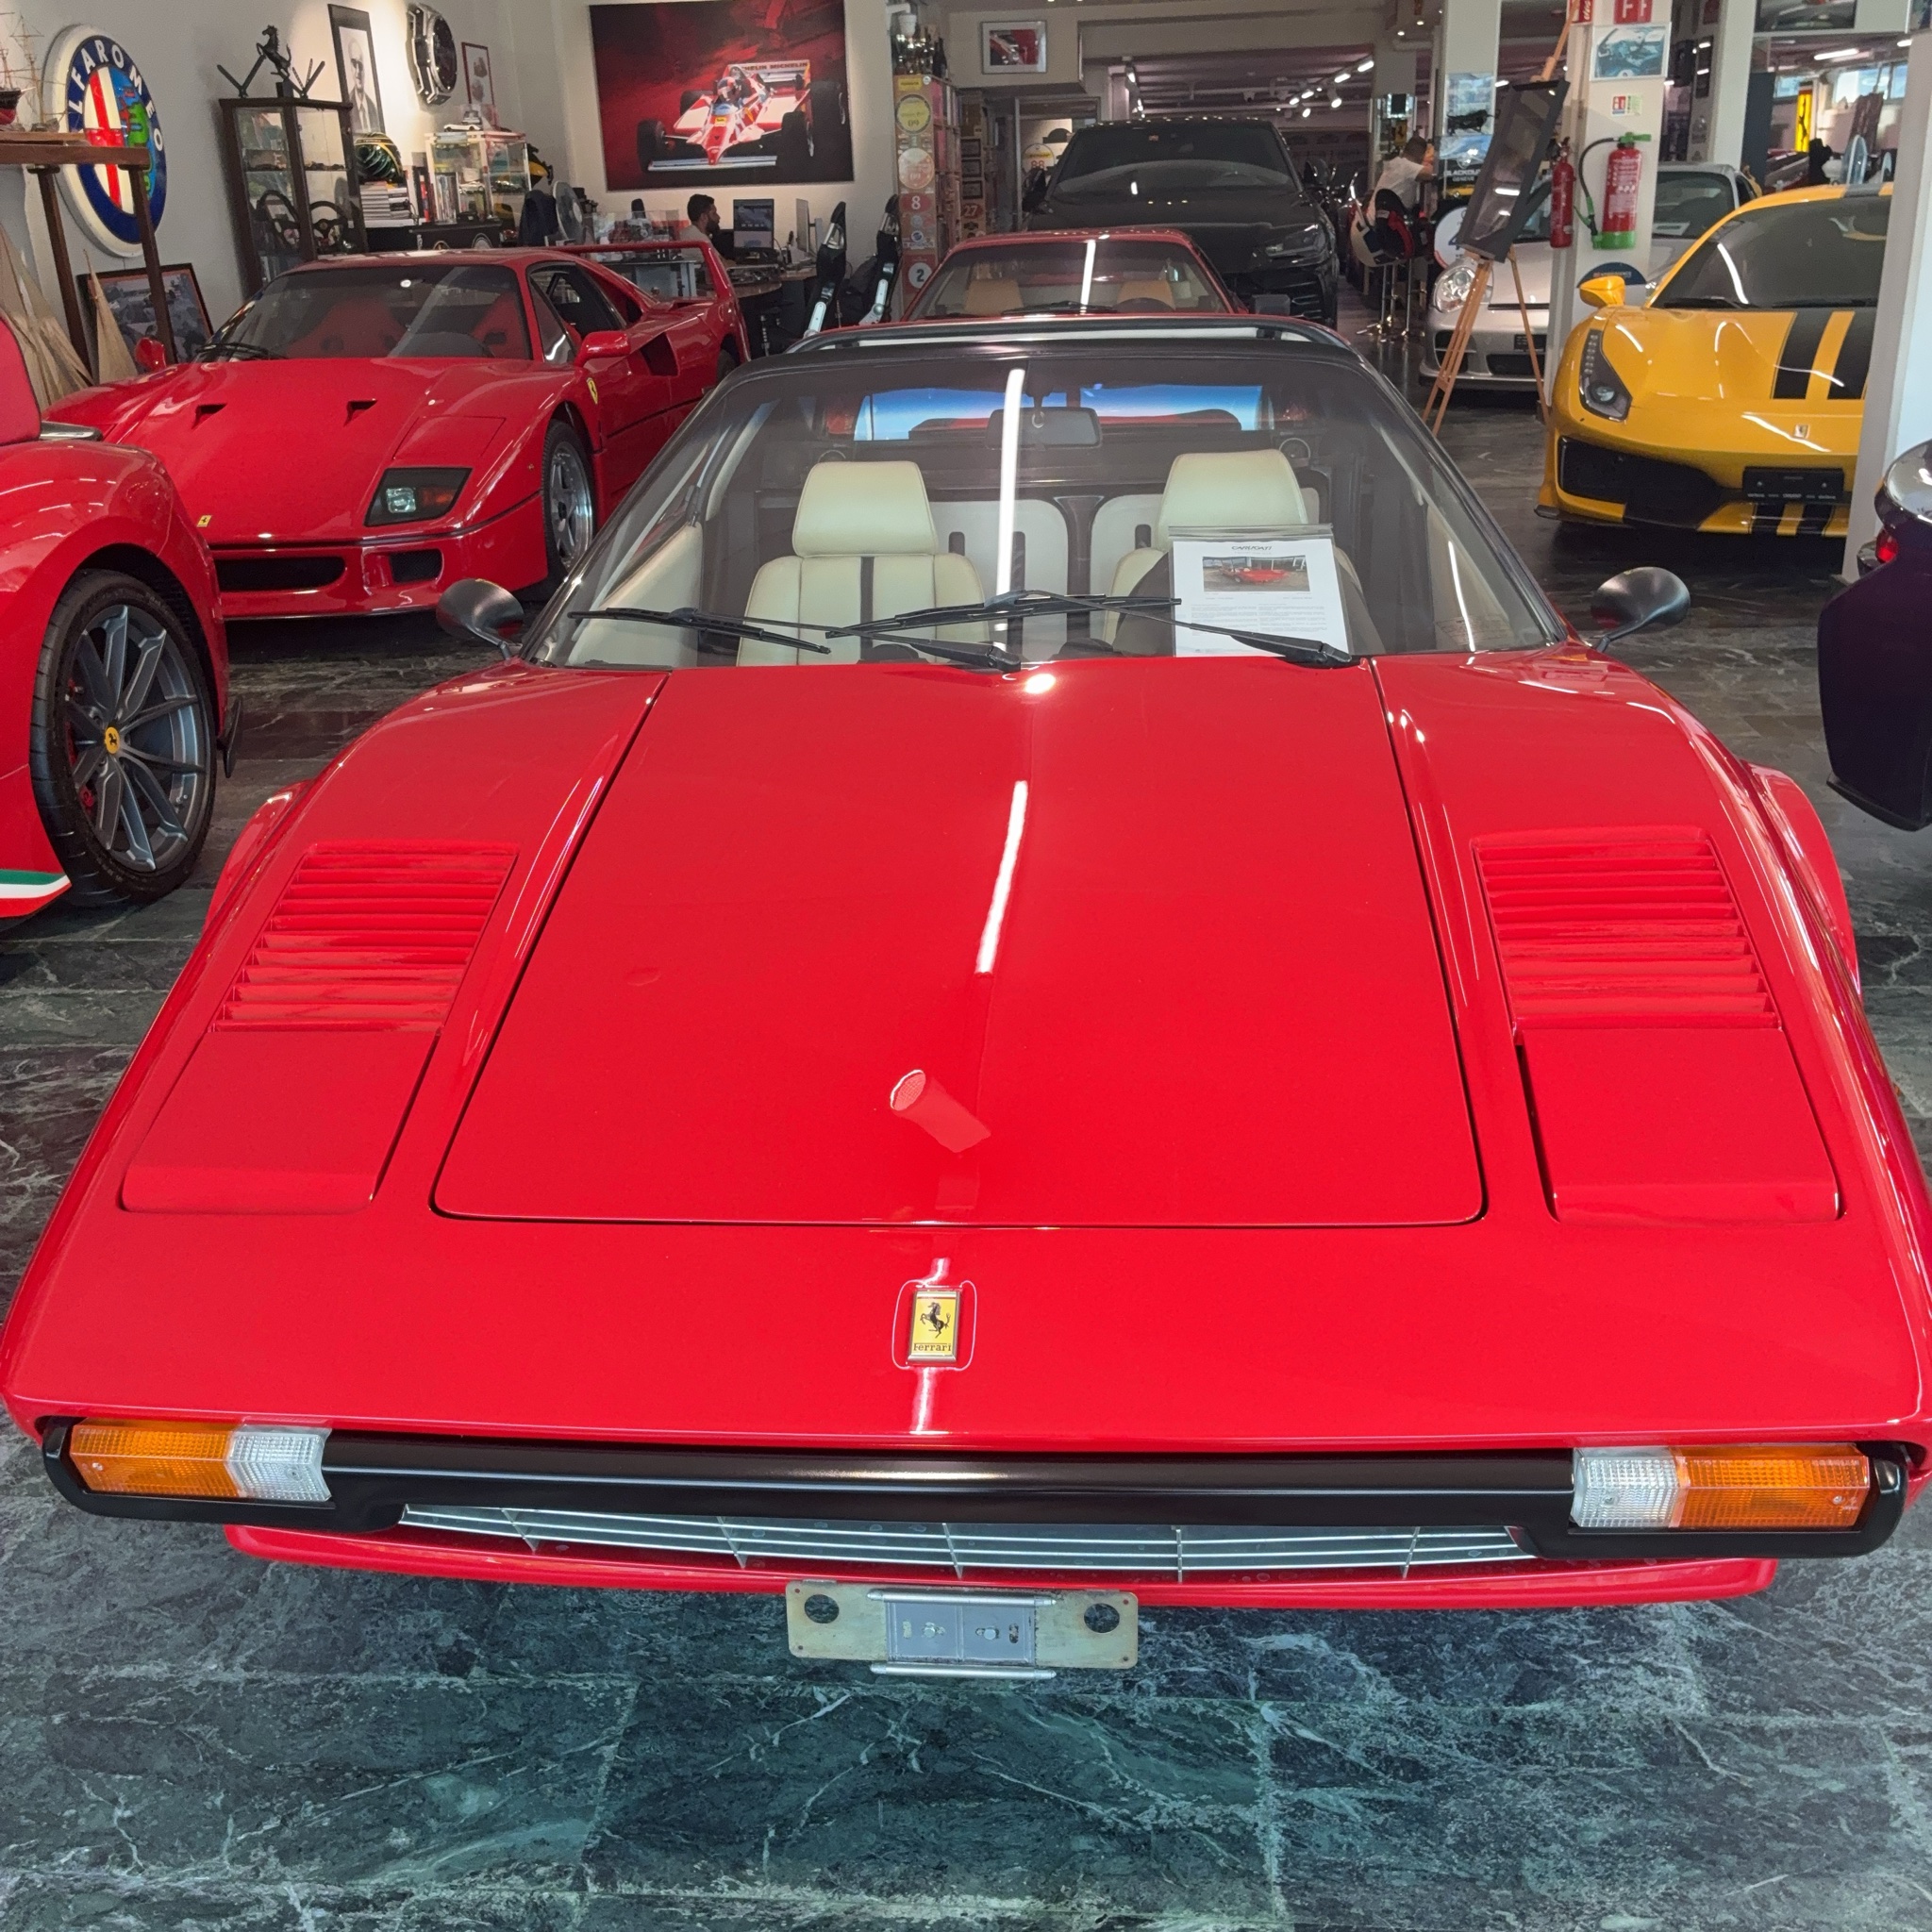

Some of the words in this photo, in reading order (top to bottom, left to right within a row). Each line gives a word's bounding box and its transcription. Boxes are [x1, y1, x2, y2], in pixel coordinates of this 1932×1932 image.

[95, 40, 163, 152] ROMEO
[911, 195, 921, 209] 8
[964, 205, 978, 216] 27
[916, 269, 924, 282] 2
[913, 1342, 952, 1351] Ferrari
